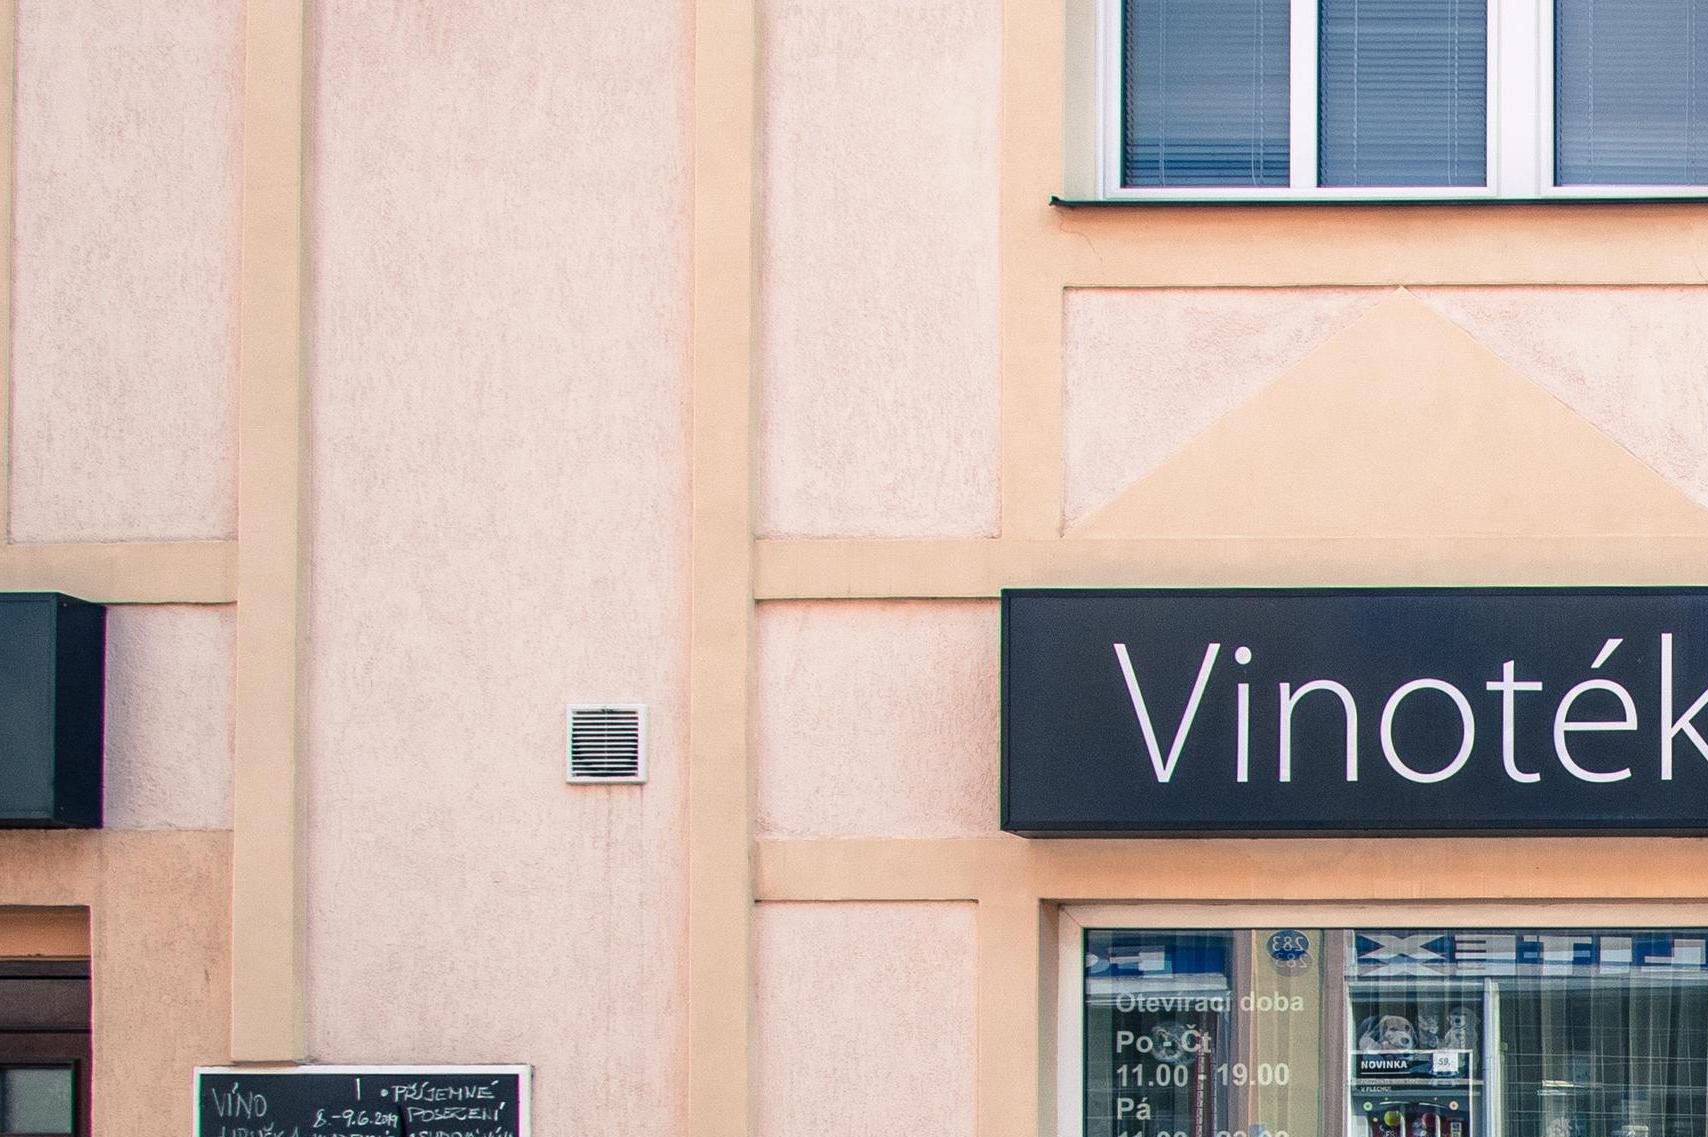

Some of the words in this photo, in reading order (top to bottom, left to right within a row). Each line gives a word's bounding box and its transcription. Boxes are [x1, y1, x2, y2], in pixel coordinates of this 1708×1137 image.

[1116, 991, 1232, 1013] Otevírací
[1240, 991, 1304, 1012] doba
[1116, 1031, 1153, 1053] Po
[1180, 1024, 1211, 1053] Čt
[1116, 1063, 1188, 1087] 11.00
[1217, 1063, 1290, 1087] 19.00
[1361, 1060, 1407, 1070] NOVINKA
[212, 1082, 267, 1119] VÍNO
[407, 1102, 506, 1122] POSEZENÍ
[1116, 1097, 1151, 1120] Pá
